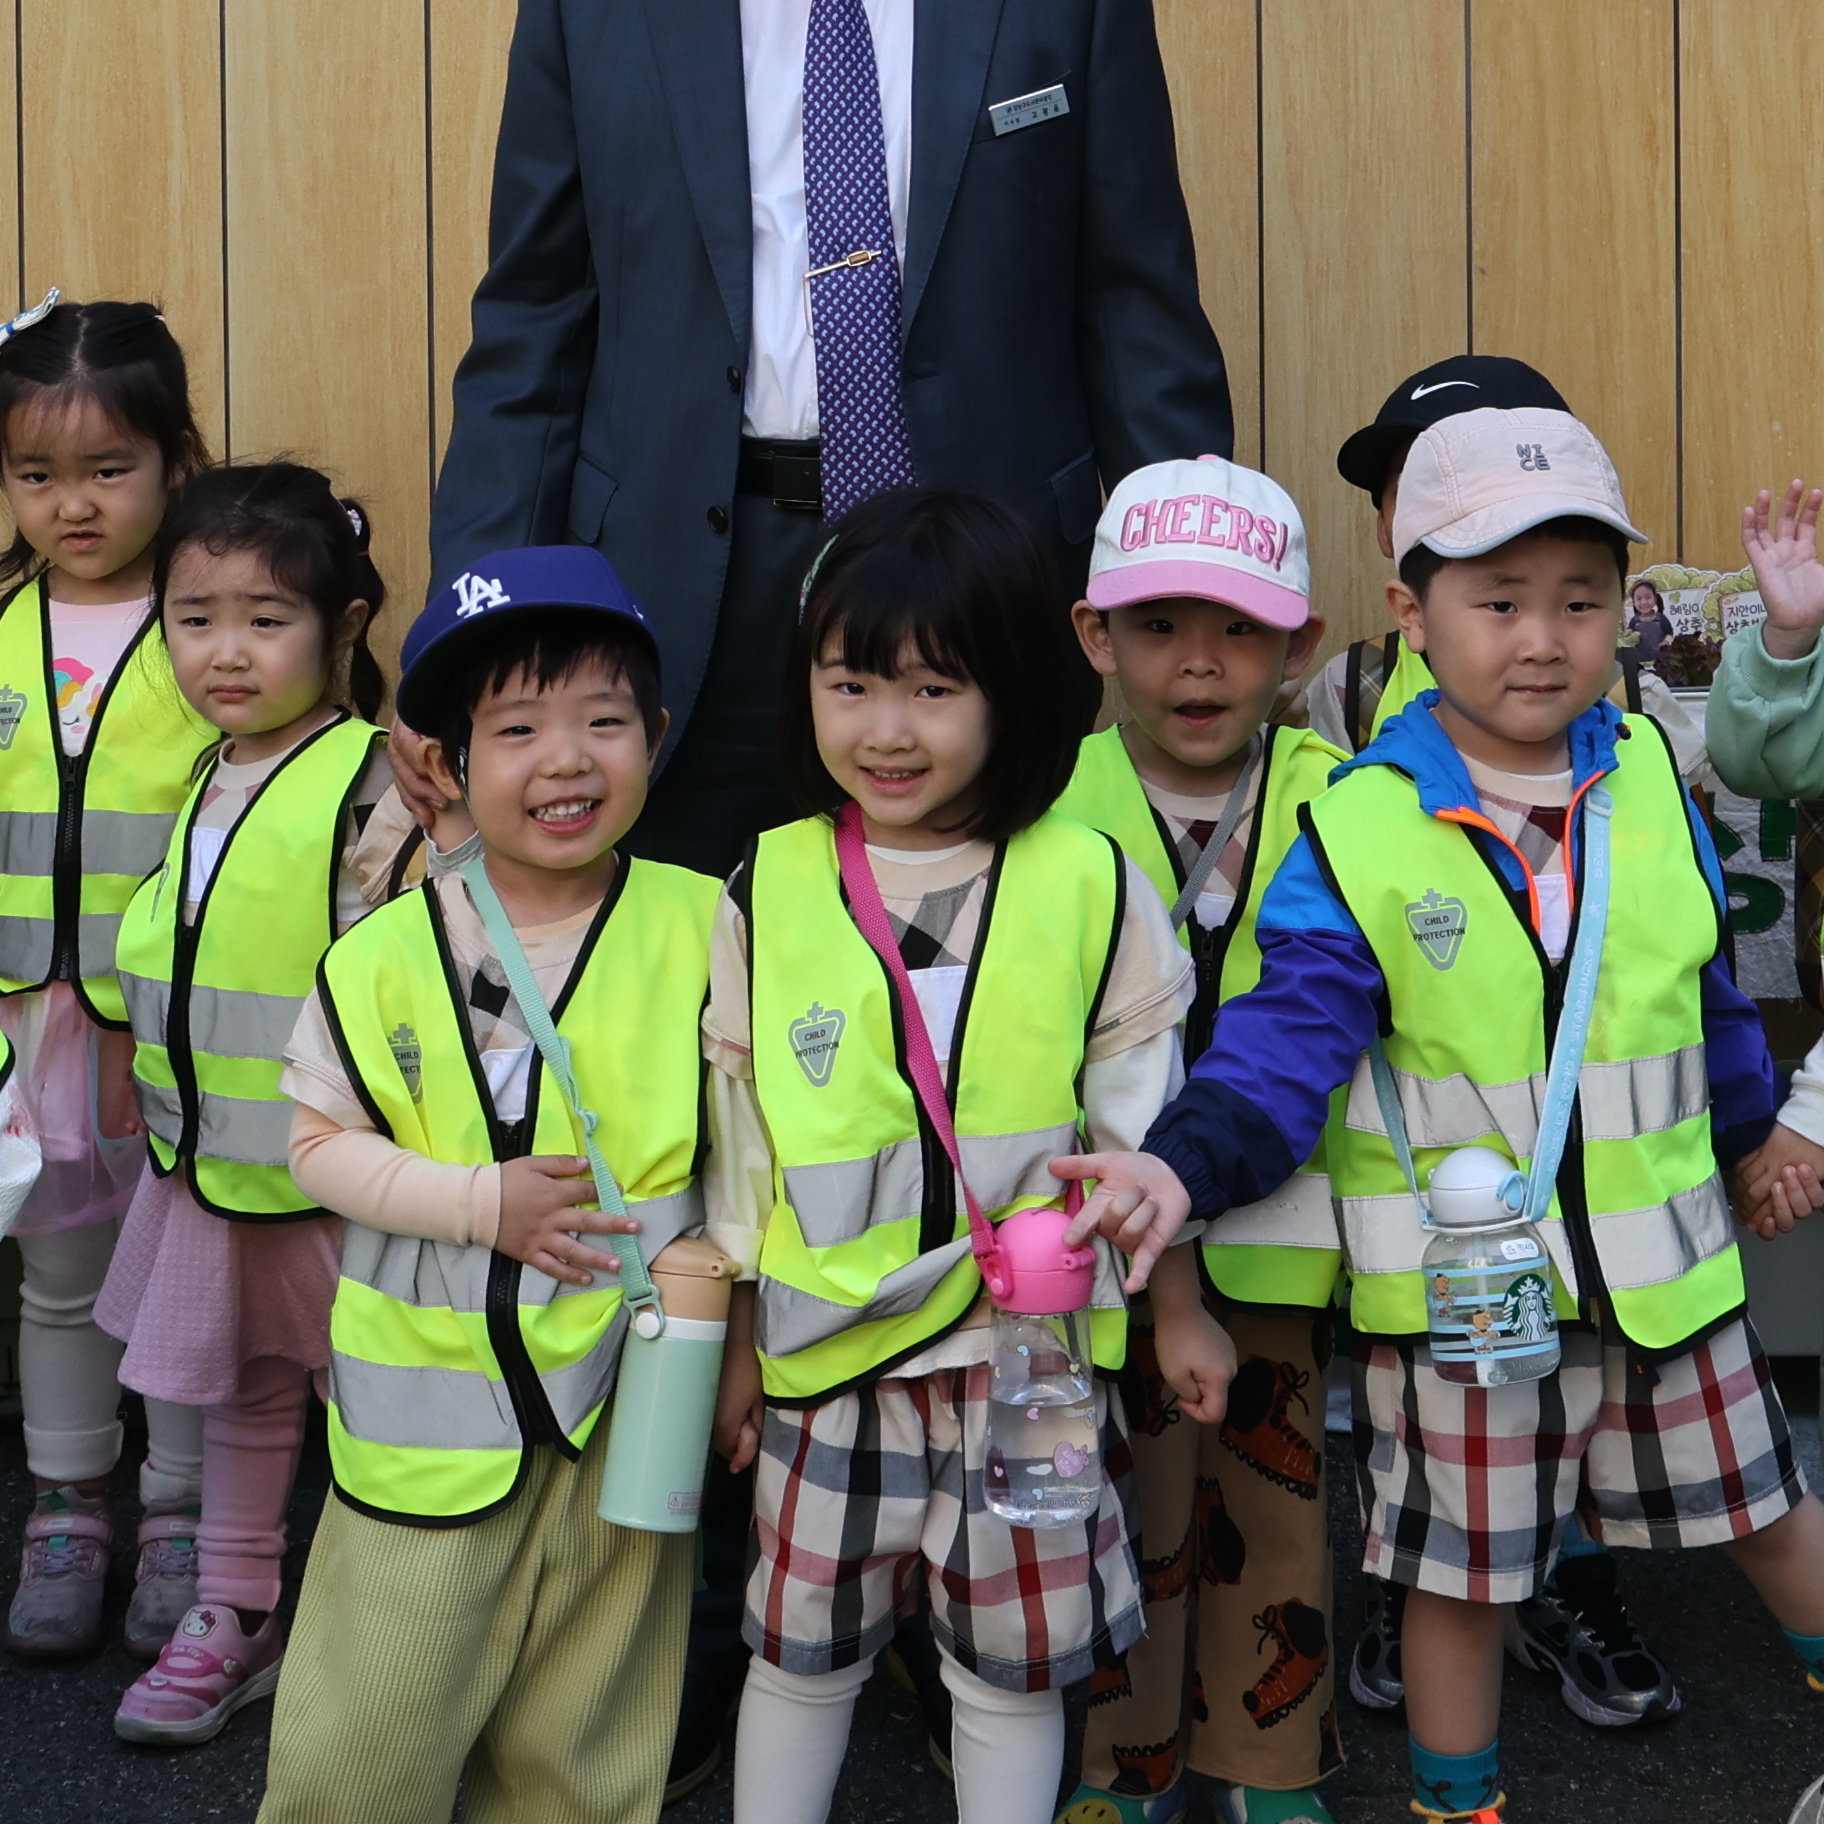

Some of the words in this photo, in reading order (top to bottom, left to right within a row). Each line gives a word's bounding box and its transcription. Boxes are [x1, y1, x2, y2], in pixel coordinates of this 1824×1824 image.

[1120, 494, 1288, 572] CHEERS!
[452, 572, 510, 618] LA
[1676, 617, 1705, 633] 상추
[1424, 915, 1449, 926] CHILD
[1413, 927, 1465, 942] PROTECTION
[804, 1029, 826, 1042] CHILD
[394, 1051, 419, 1061] CHILD
[795, 1041, 839, 1058] PROTECTION
